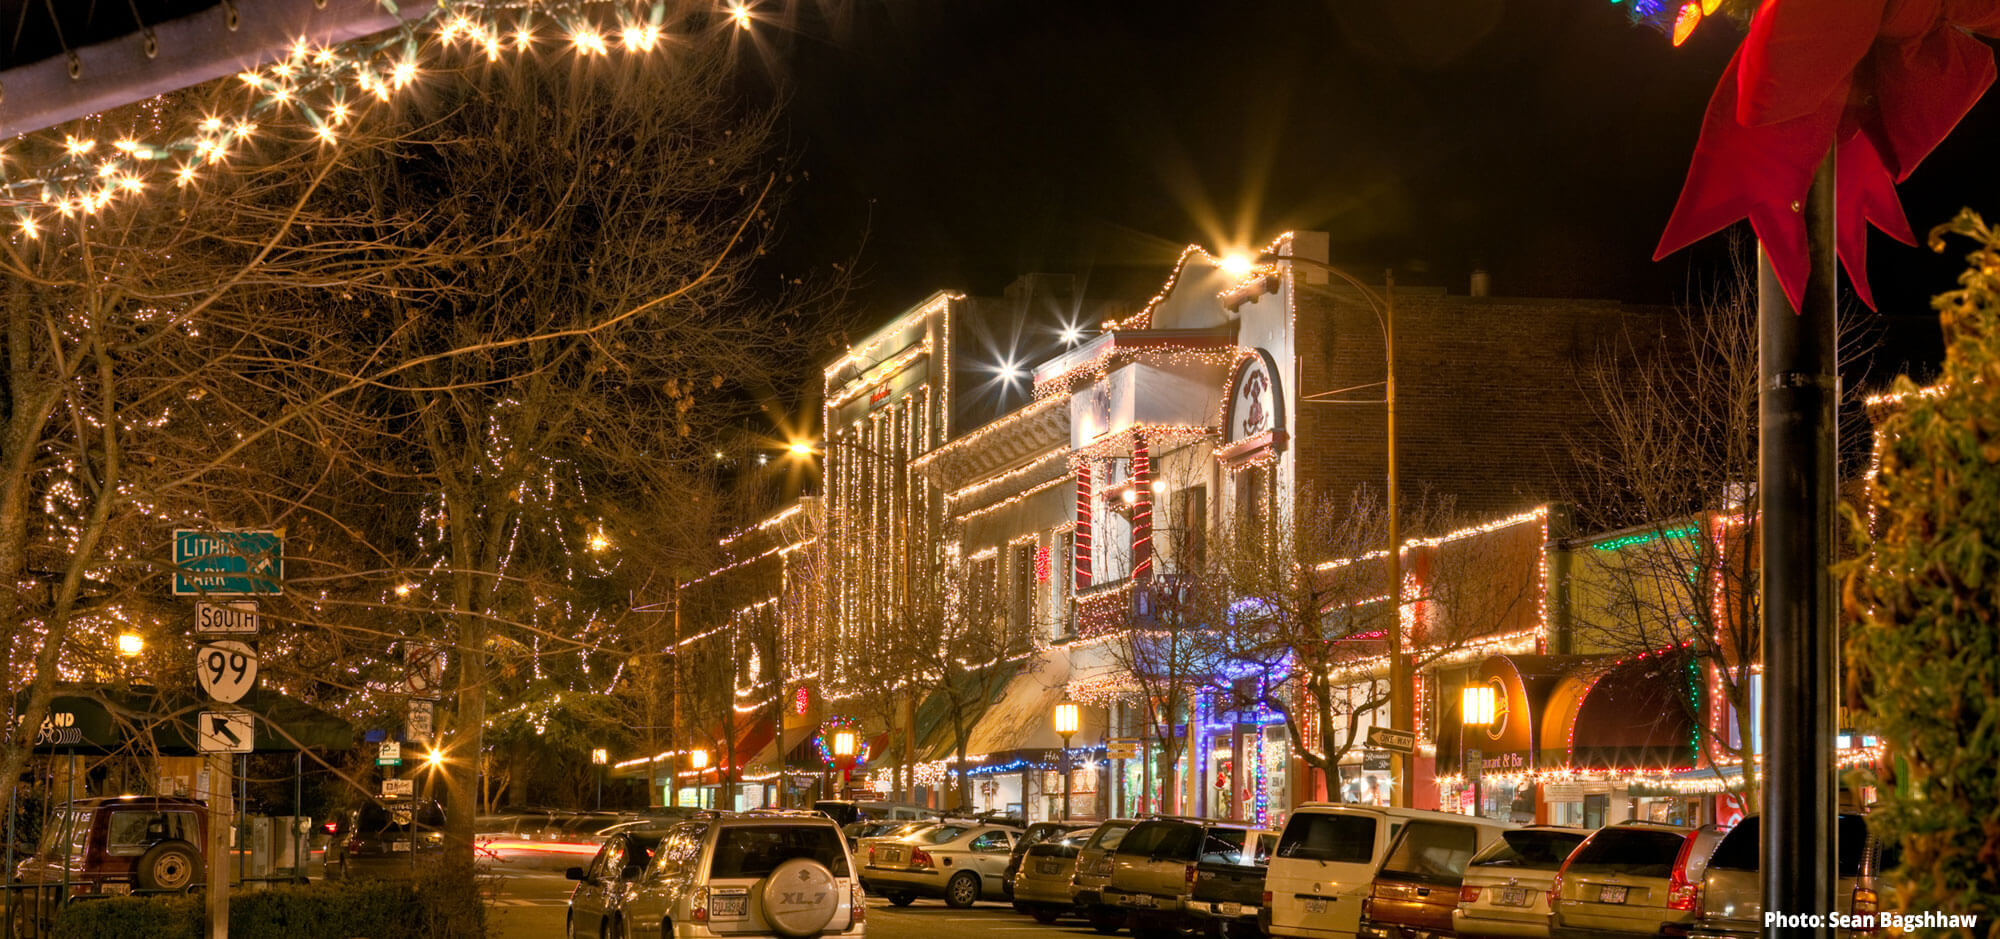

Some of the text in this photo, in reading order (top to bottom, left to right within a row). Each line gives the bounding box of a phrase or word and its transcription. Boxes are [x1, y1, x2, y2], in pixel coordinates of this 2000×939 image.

[201, 607, 254, 628] SOUTH
[208, 651, 247, 685] 99
[1380, 734, 1412, 746] ONE WAY
[1511, 752, 1523, 768] Bar
